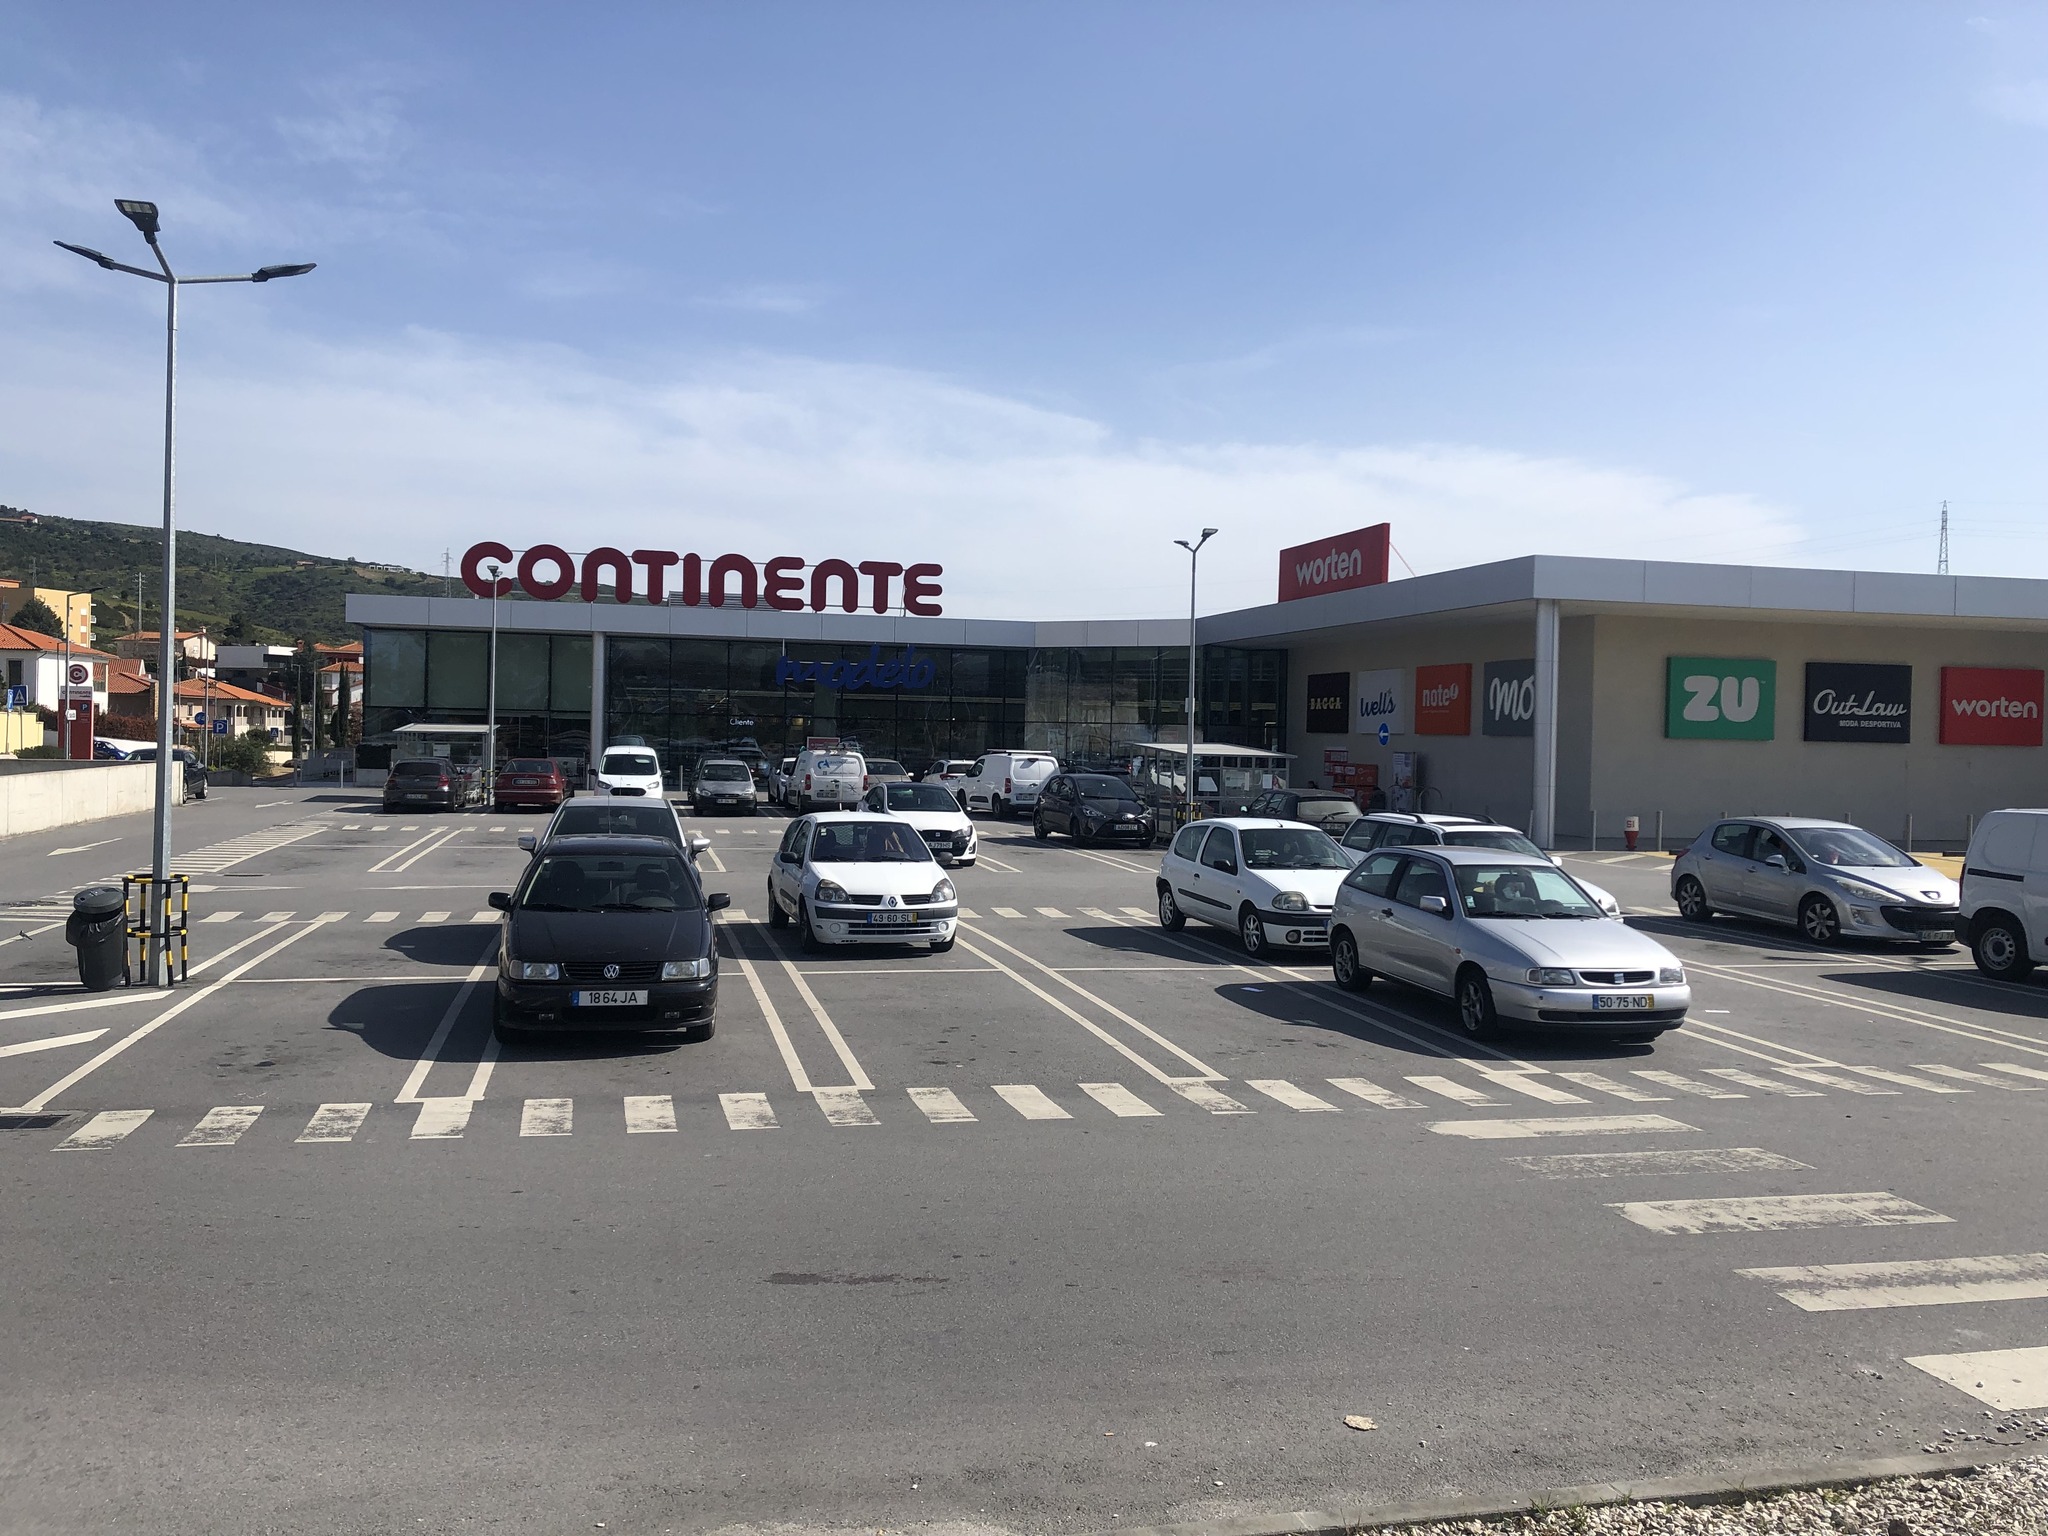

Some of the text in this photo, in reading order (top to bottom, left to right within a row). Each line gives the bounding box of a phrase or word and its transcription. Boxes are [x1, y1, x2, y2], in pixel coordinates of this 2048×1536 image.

[460, 541, 943, 617] CONTINENTE
[1295, 548, 1361, 587] worten
[775, 643, 936, 690] modelo
[1309, 697, 1342, 710] BAGGA
[1682, 675, 1760, 723] ZU
[1952, 696, 2038, 719] worten
[1839, 719, 1902, 729] MODA DESPORTIVA
